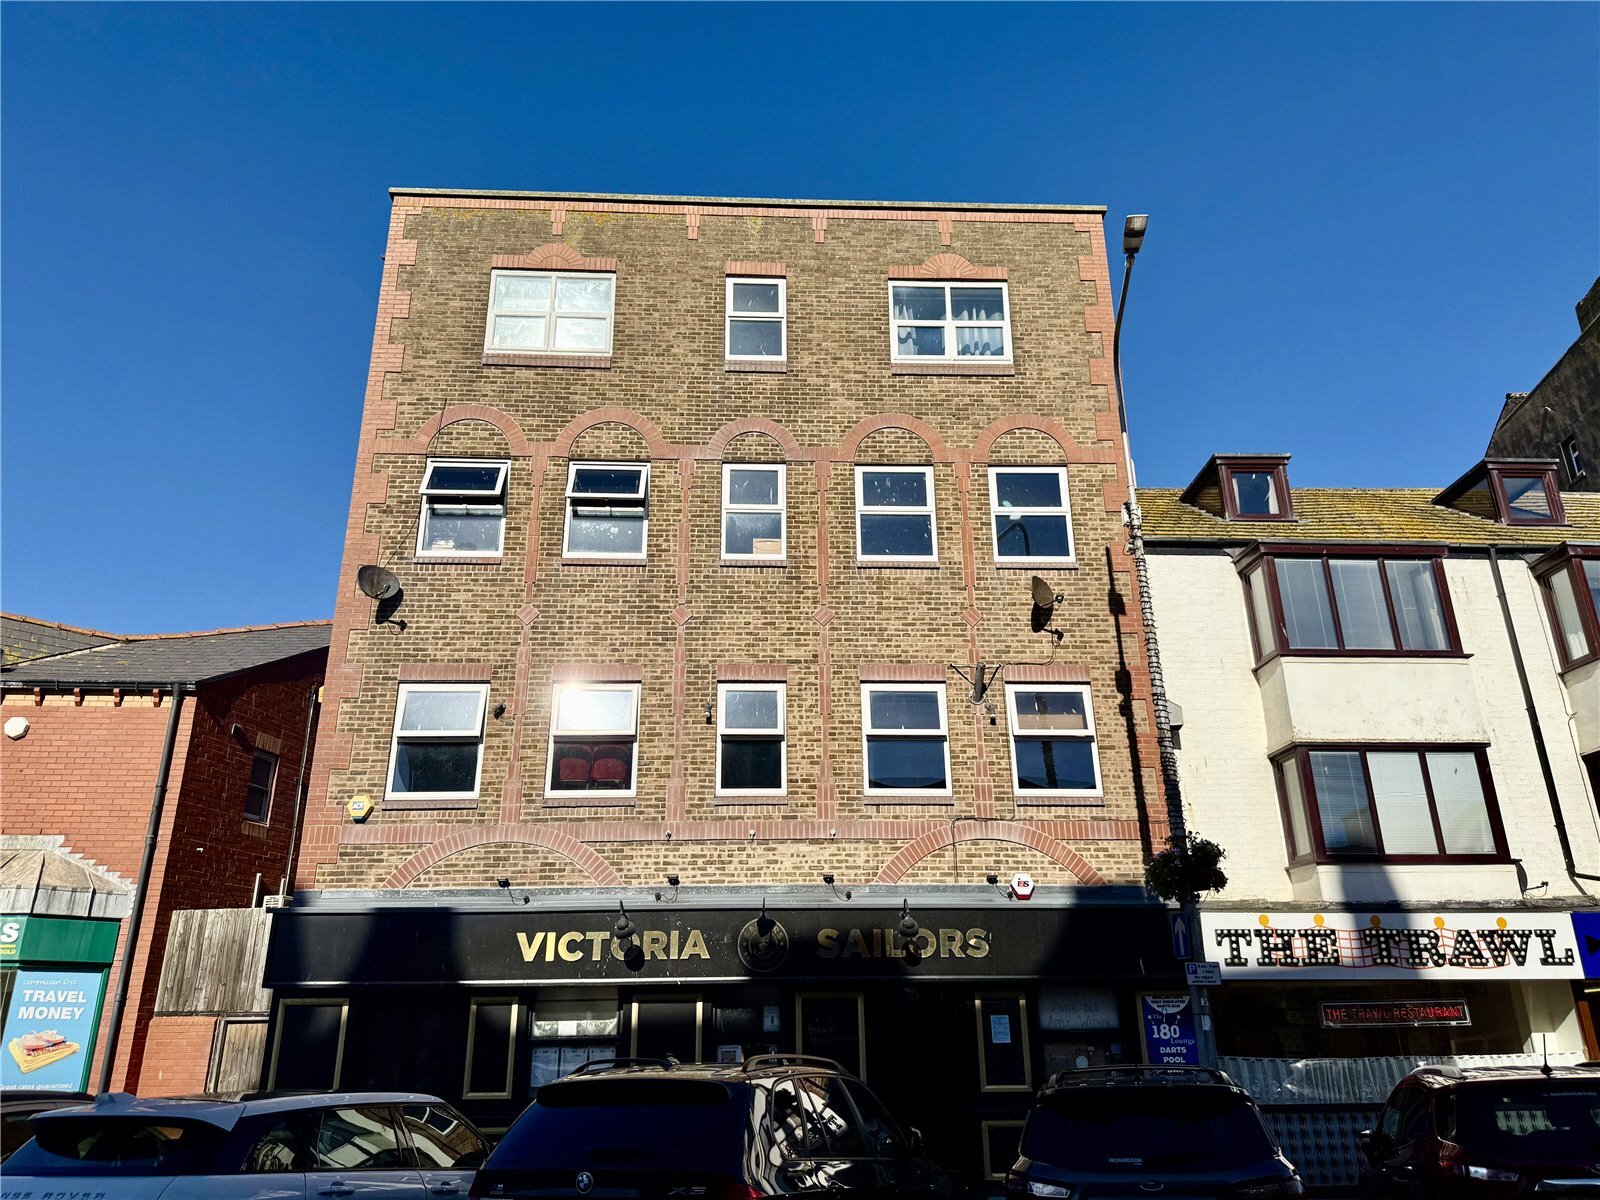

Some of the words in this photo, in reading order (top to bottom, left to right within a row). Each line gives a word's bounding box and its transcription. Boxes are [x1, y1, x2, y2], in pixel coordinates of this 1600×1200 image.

[0, 922, 20, 943] S
[516, 930, 711, 962] VICTORIA
[816, 927, 990, 959] SAILORS
[1215, 928, 1340, 967] THE
[1363, 928, 1574, 967] TRAWL
[22, 990, 87, 1003] TRAVEL
[18, 1006, 85, 1020] MONEY
[1325, 1008, 1348, 1020] THE
[1352, 1007, 1388, 1020] TRAWL
[1393, 1005, 1464, 1019] RESTAURANT
[1152, 1023, 1180, 1040] 180
[1170, 1037, 1195, 1045] Lounge
[1160, 1046, 1187, 1054] DARTS
[36, 1082, 74, 1090] guaranteed
